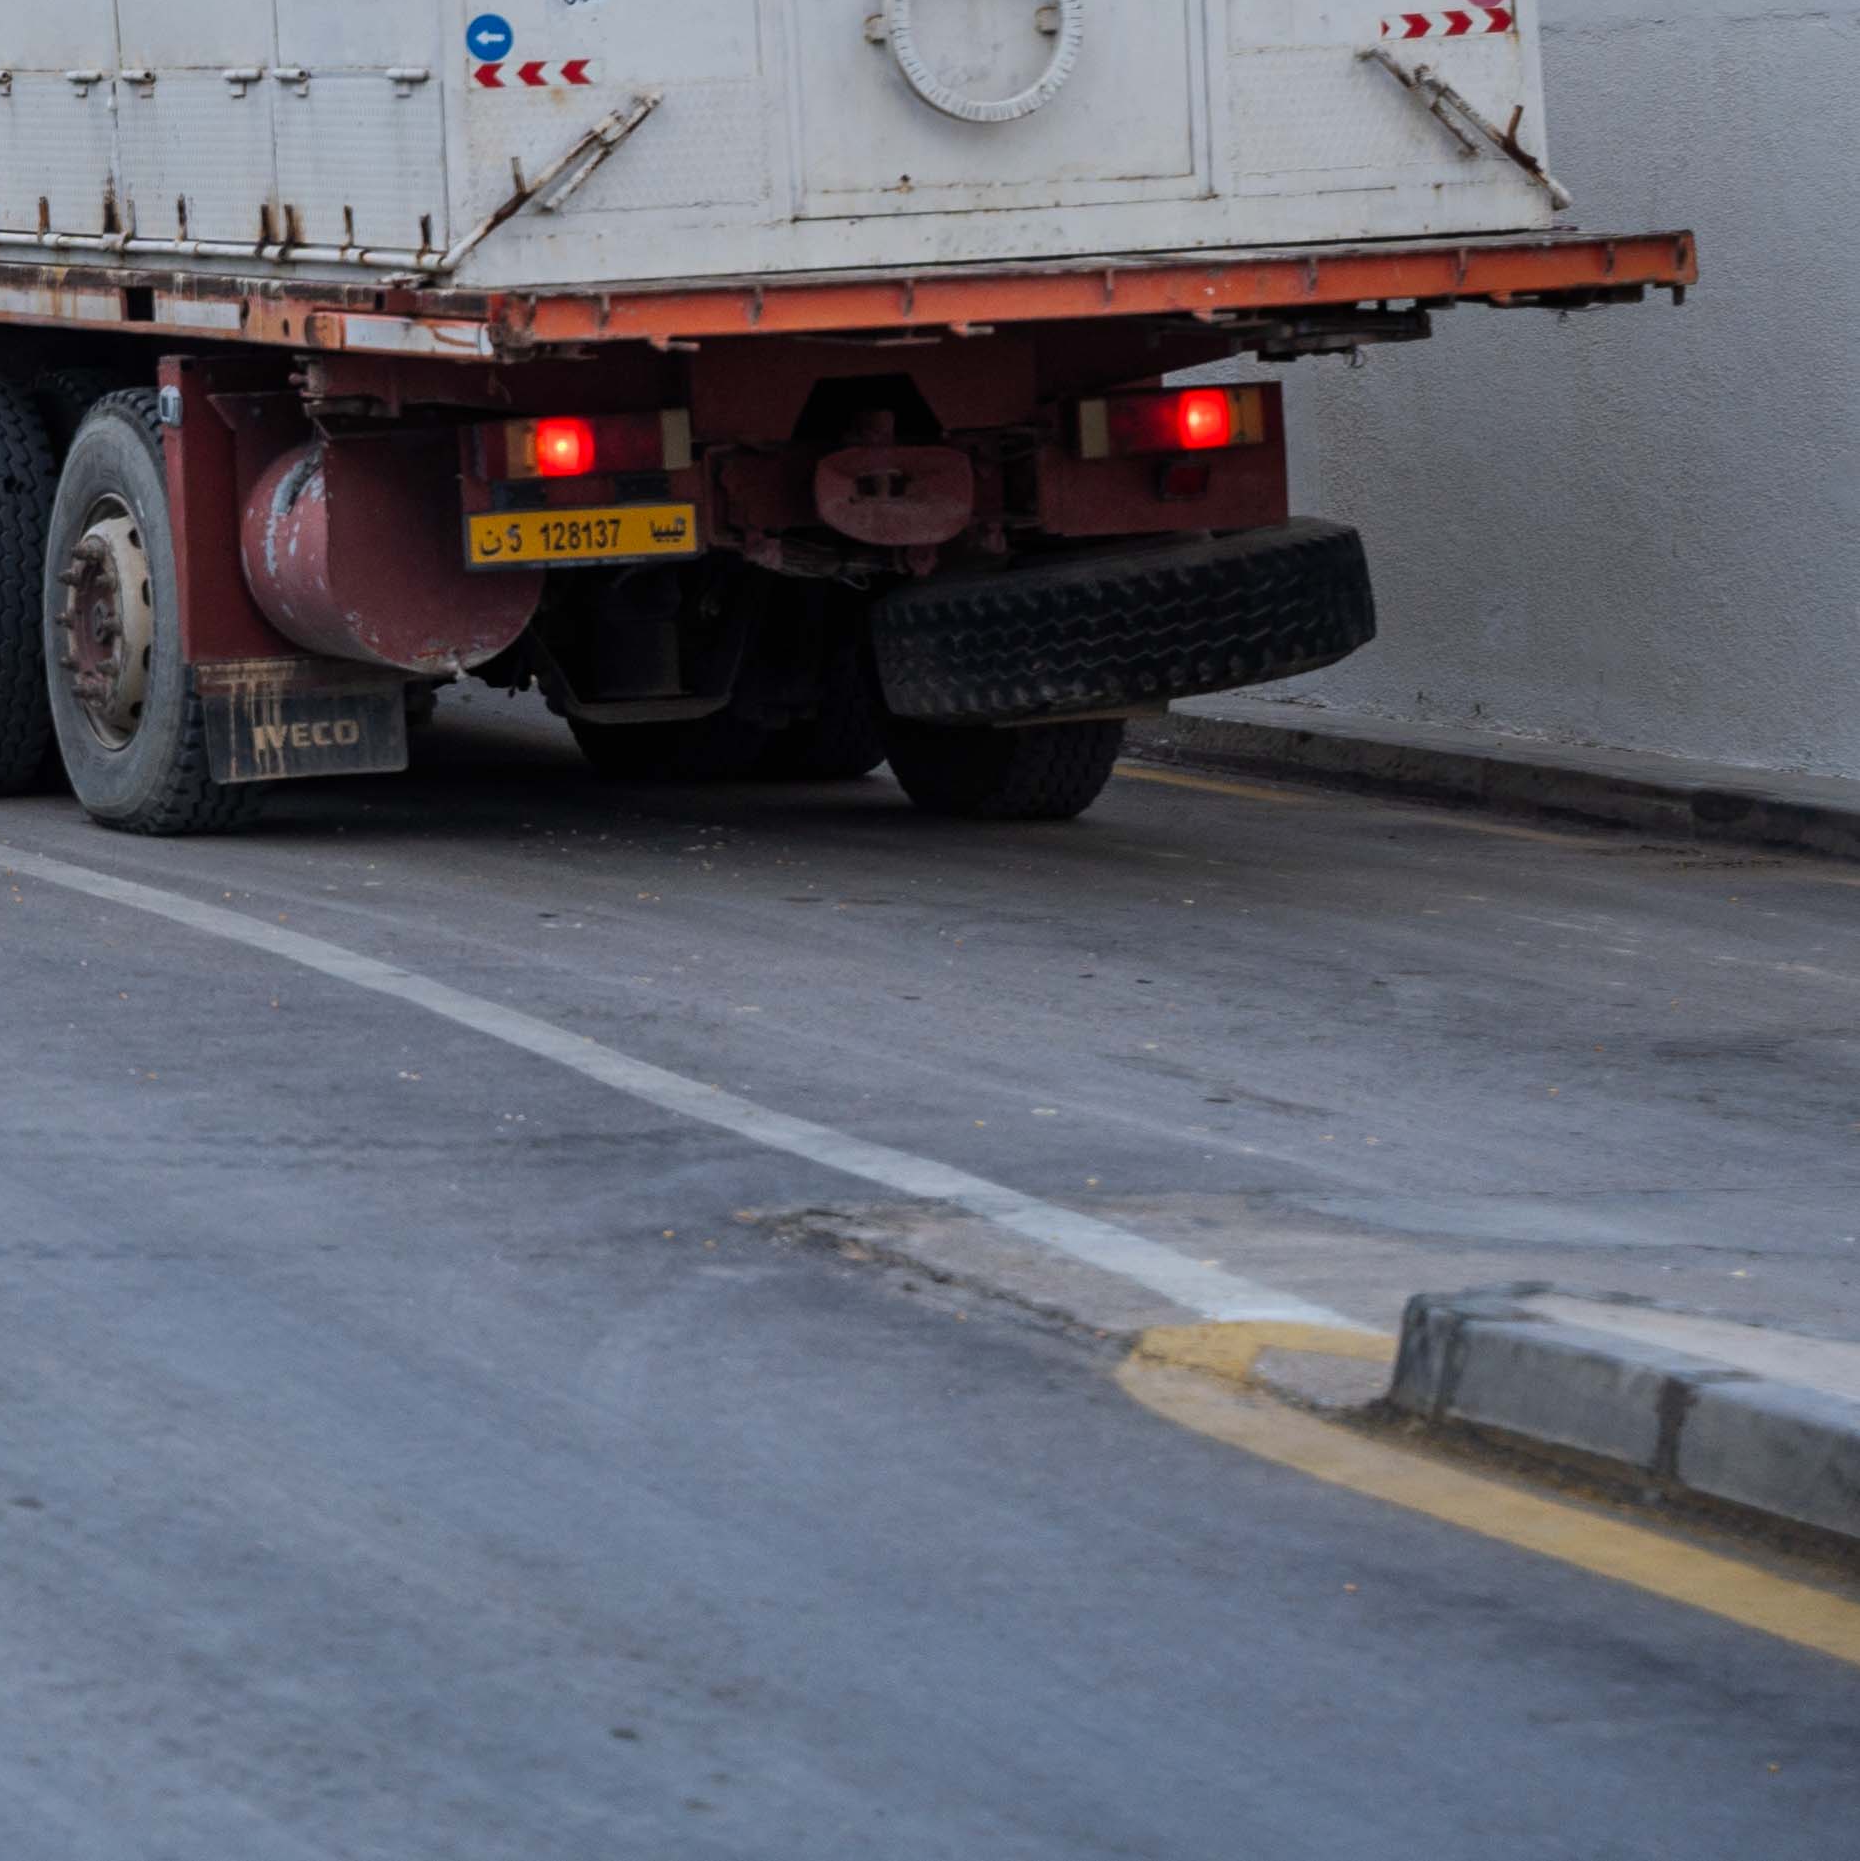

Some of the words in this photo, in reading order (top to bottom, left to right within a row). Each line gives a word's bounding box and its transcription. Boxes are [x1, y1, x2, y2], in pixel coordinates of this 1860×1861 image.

[540, 518, 621, 551] 128137
[649, 516, 687, 543] ليبيا
[253, 719, 360, 751] IVECO
